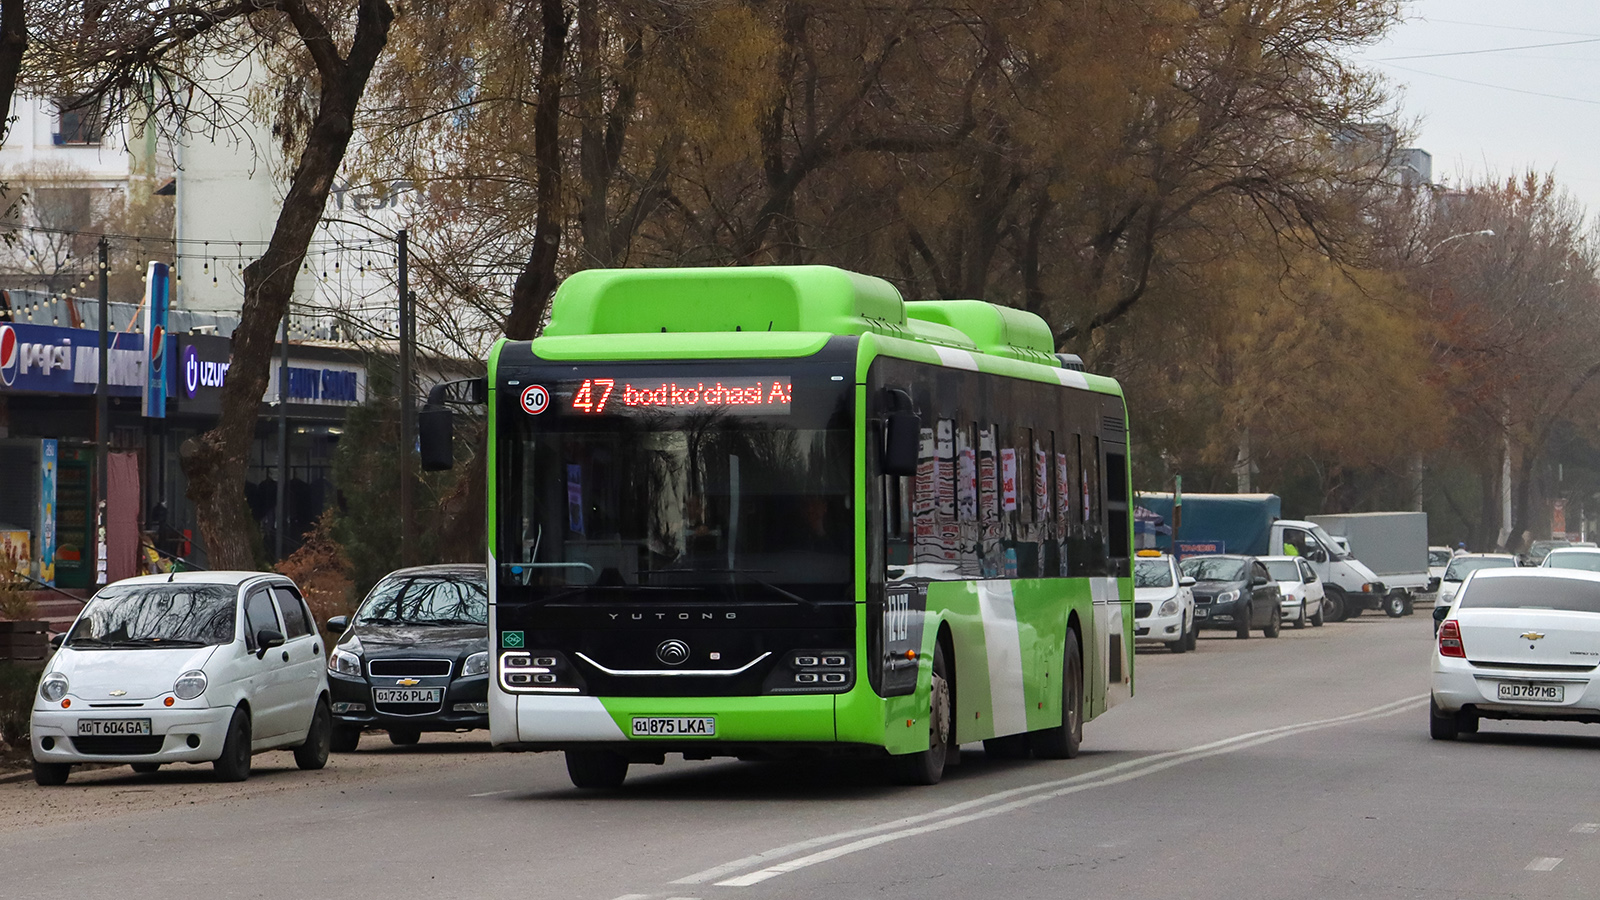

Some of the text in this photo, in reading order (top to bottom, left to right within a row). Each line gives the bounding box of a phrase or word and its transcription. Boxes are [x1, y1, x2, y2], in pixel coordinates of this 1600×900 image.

[20, 338, 71, 376] pepsi
[525, 393, 544, 406] 50
[573, 379, 615, 413] 47
[378, 690, 433, 702] 01 736 PLA
[1502, 686, 1557, 698] 01 D 787 MB
[81, 722, 142, 734] 10 T 604 GA
[635, 719, 706, 733] 01 875 LKA
